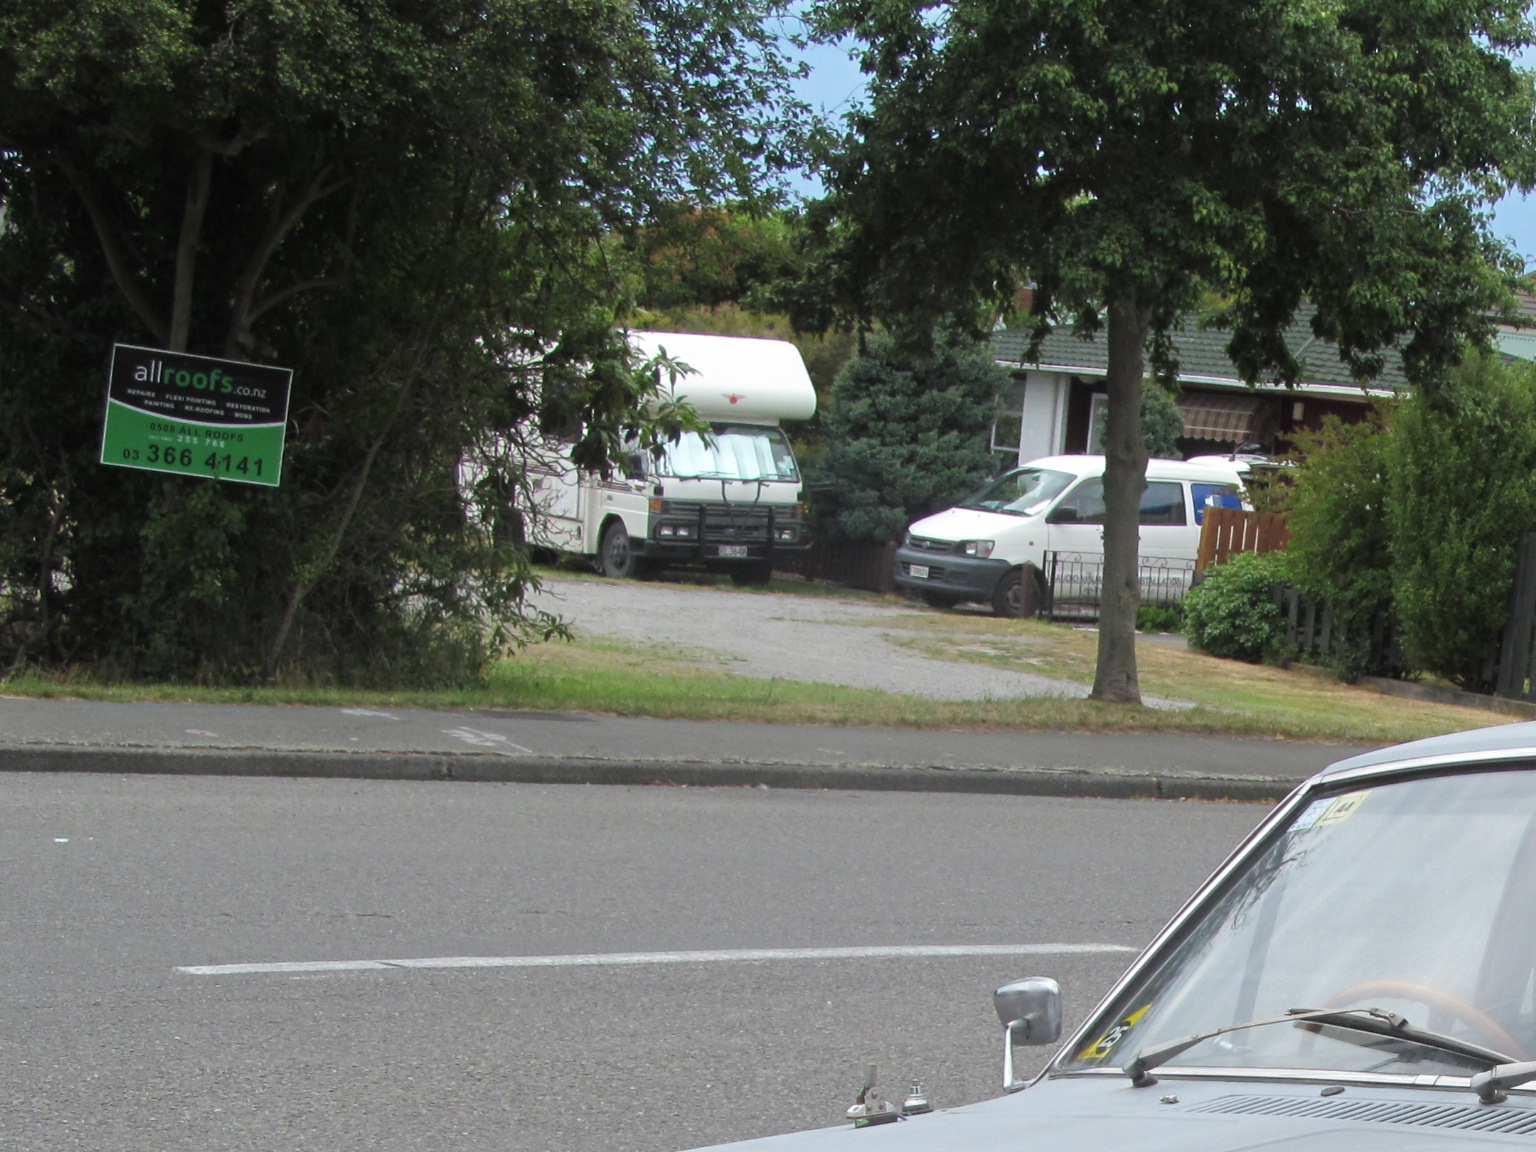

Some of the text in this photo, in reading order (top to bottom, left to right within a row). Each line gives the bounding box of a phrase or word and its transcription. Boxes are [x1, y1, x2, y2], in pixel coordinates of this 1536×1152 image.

[134, 360, 267, 399] allroofs.co.nz
[127, 388, 156, 398] REPAIRS
[186, 397, 217, 406] POINTING
[226, 402, 271, 413] RESTORATION
[144, 400, 175, 409] PAINTING
[184, 405, 225, 416] RE-ROOFING
[150, 423, 244, 442] 0508 ALL ROOFS
[177, 435, 199, 445] 255
[123, 444, 263, 476] 03 366 4141
